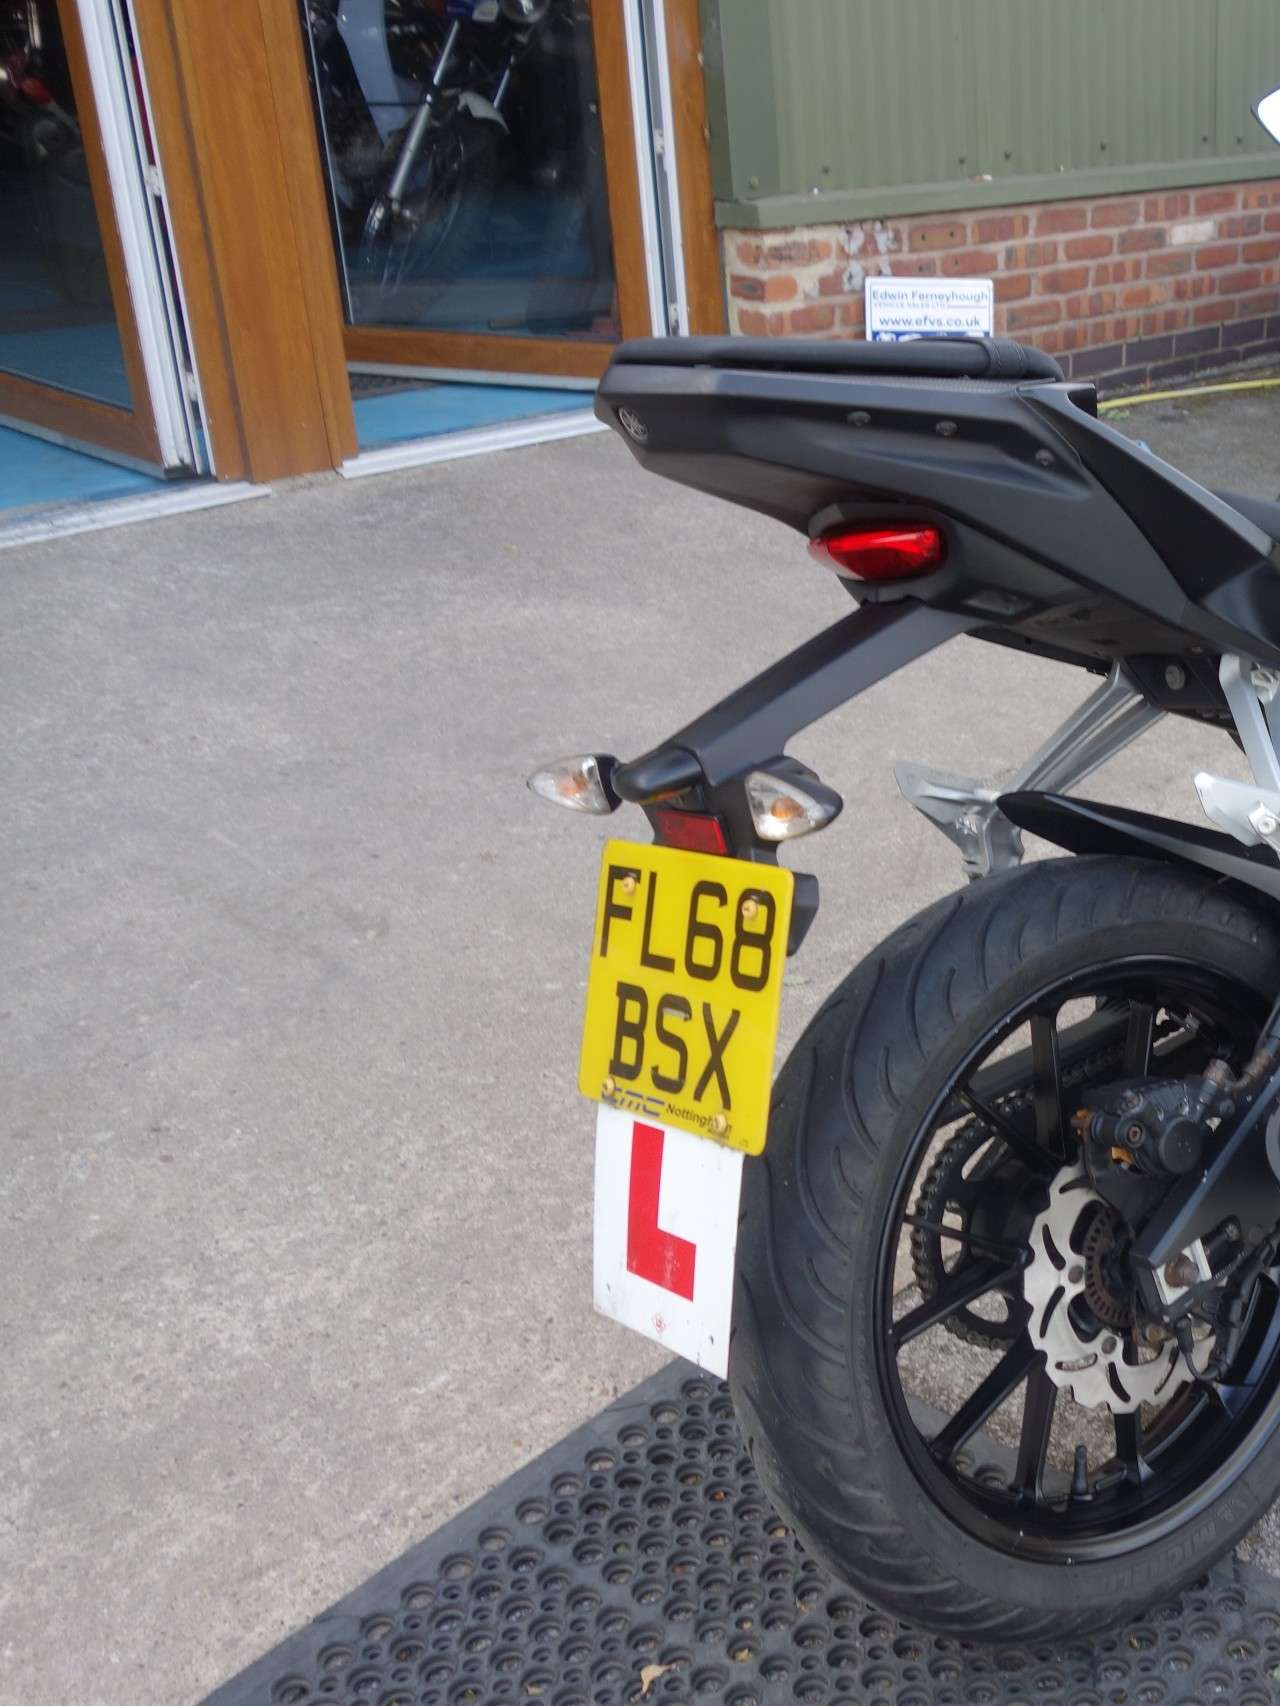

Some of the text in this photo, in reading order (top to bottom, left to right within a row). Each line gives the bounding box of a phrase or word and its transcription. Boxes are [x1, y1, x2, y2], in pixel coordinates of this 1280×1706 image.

[872, 290, 988, 302] Edwin Ferneyhough
[879, 316, 981, 327] www.efvs.co.uk
[599, 864, 776, 993] FL68
[609, 980, 741, 1111] BSX
[666, 1103, 732, 1135] Nottinghm
[626, 1121, 696, 1302] L
